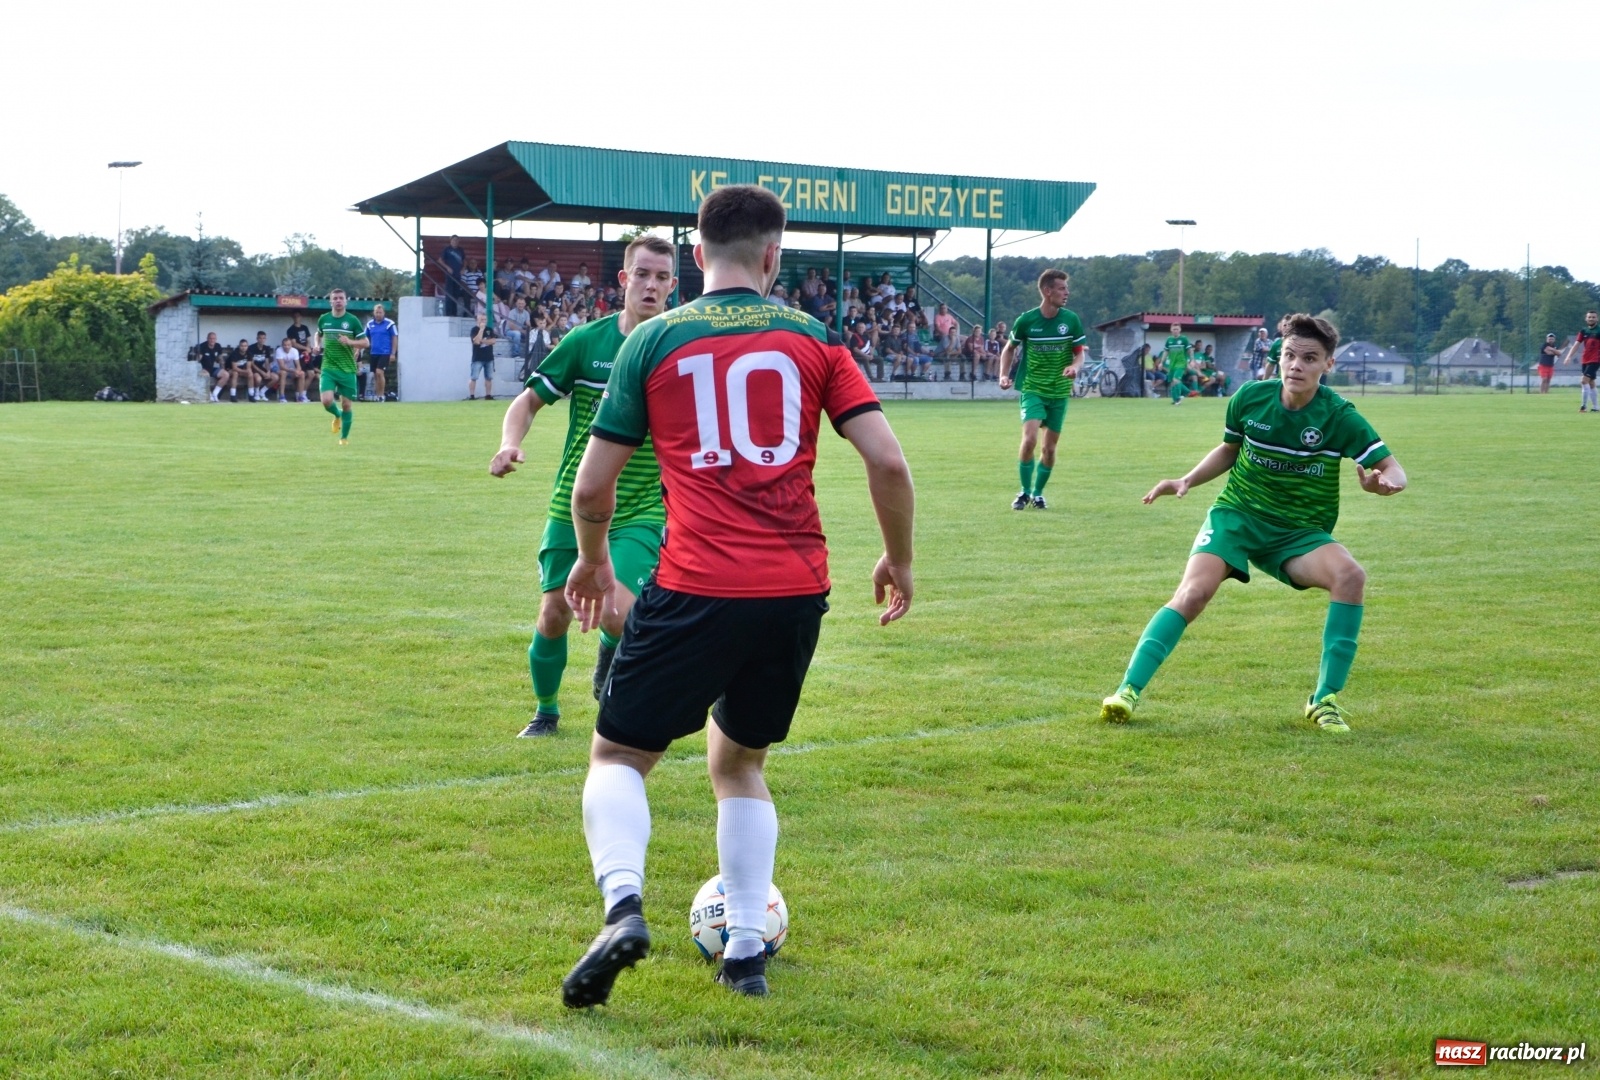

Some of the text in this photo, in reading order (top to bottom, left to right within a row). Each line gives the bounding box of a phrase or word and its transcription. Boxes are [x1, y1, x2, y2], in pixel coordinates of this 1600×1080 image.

[887, 184, 1003, 219] GORZYCE
[667, 311, 809, 326] PRACOWNIA FLORYSTYCZNA
[711, 320, 770, 328] GORZYCZKI
[677, 351, 801, 469] 10
[691, 903, 725, 927] SELEC
